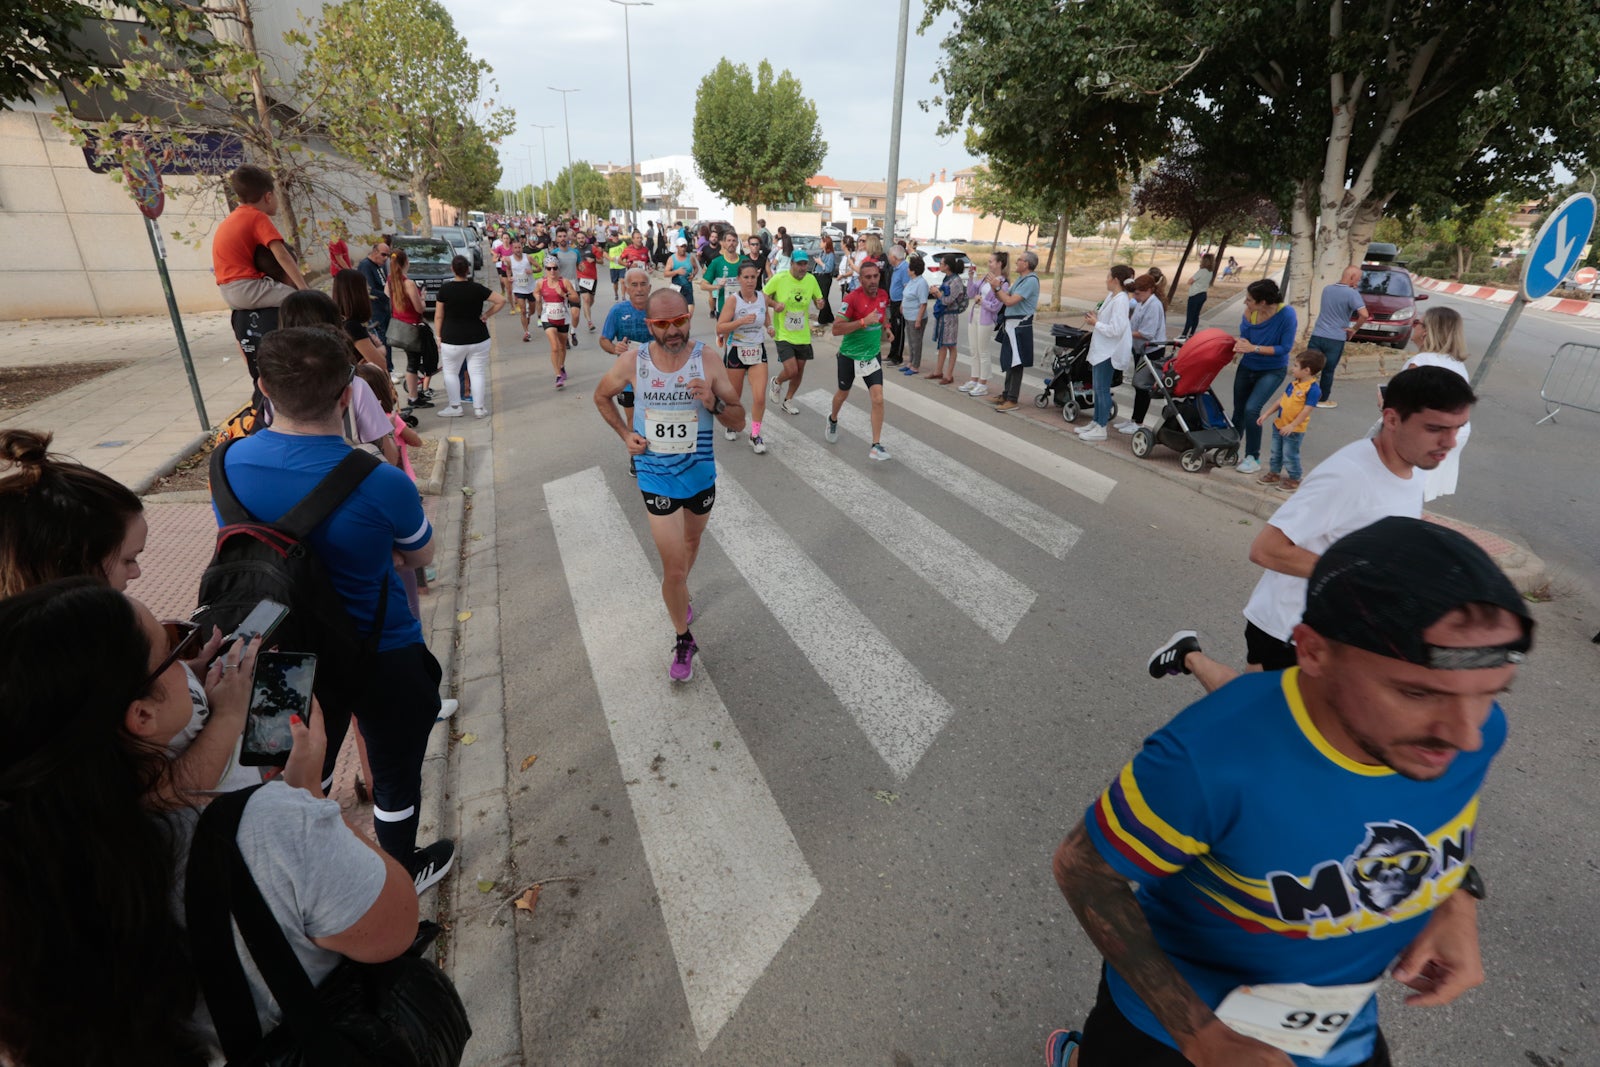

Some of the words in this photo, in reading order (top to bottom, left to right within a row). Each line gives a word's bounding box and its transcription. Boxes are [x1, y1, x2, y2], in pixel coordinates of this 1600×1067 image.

[192, 142, 210, 152] DE
[741, 349, 760, 357] 2021
[656, 423, 687, 438] 813
[1281, 1011, 1349, 1033] 99
